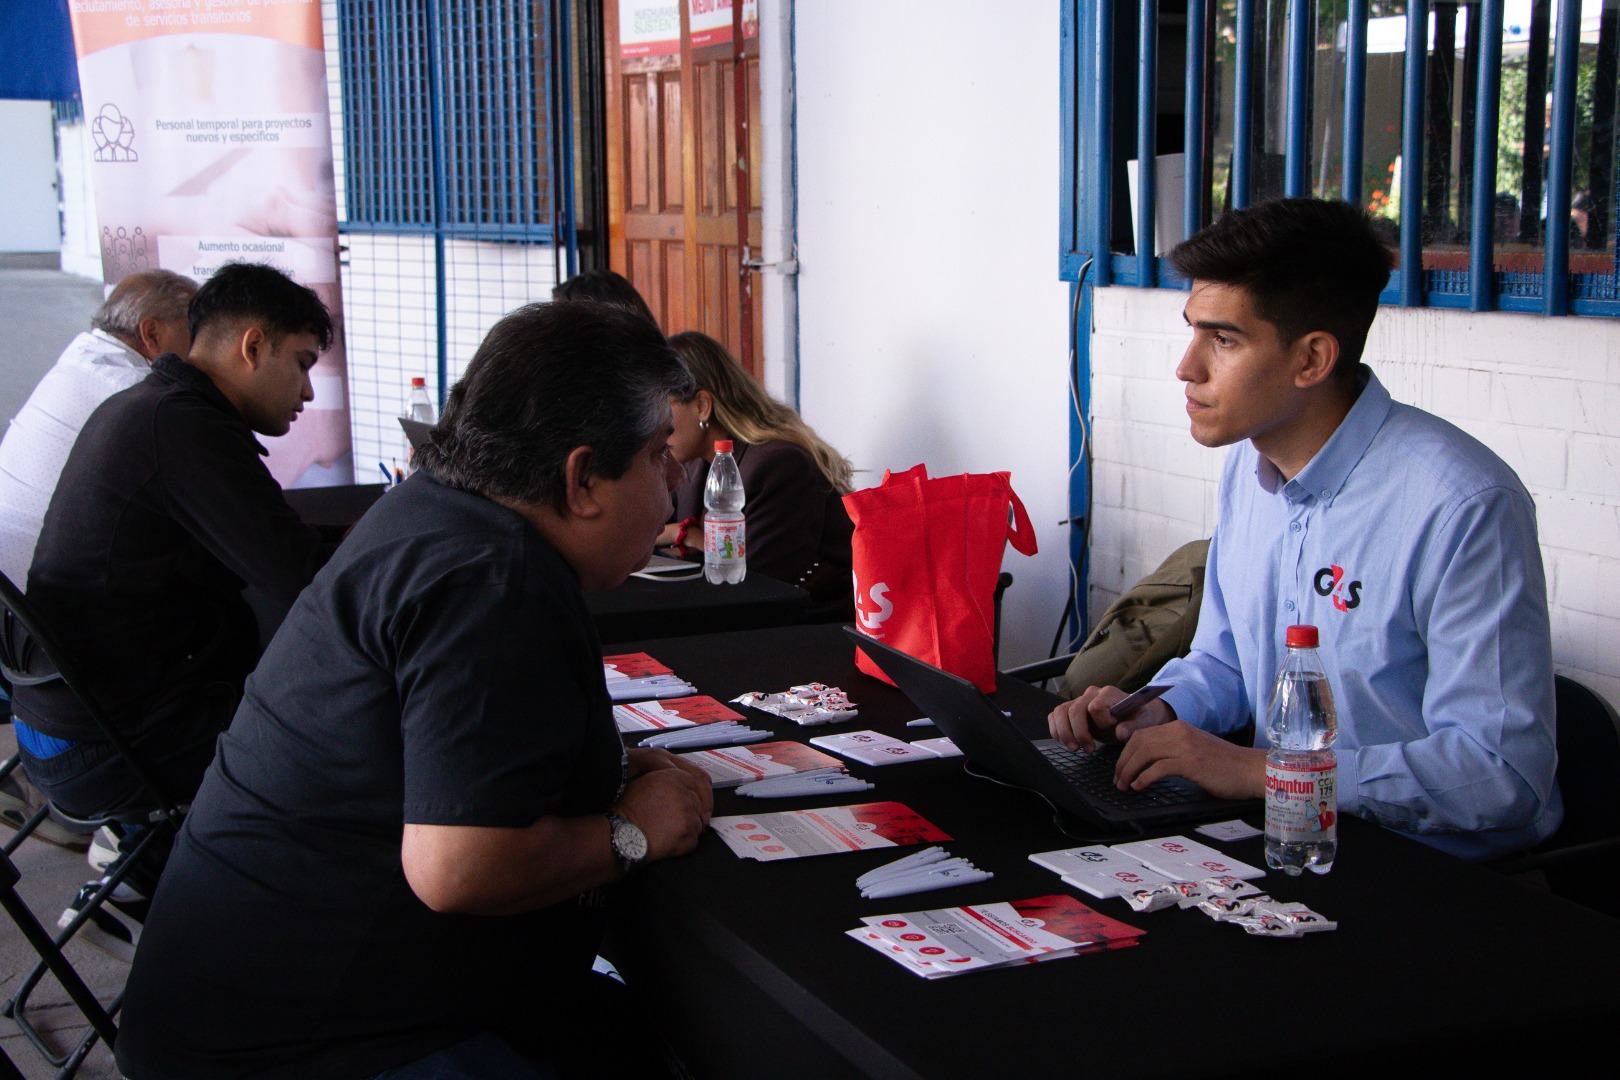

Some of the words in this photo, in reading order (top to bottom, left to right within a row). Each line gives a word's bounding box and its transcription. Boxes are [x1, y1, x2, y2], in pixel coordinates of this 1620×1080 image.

[126, 12, 140, 27] de
[144, 11, 188, 26] servicios
[191, 10, 252, 25] transitorios
[634, 17, 680, 34] SUSTENT
[156, 119, 194, 130] Personal
[196, 118, 238, 131] temporal
[242, 120, 262, 132] para
[265, 118, 312, 132] proyectos
[186, 132, 219, 142] nuevos
[221, 133, 228, 144] y
[198, 240, 240, 252] Aumento
[242, 240, 285, 253] ocasional
[1314, 564, 1362, 613] G4S
[1320, 785, 1333, 796] 175
